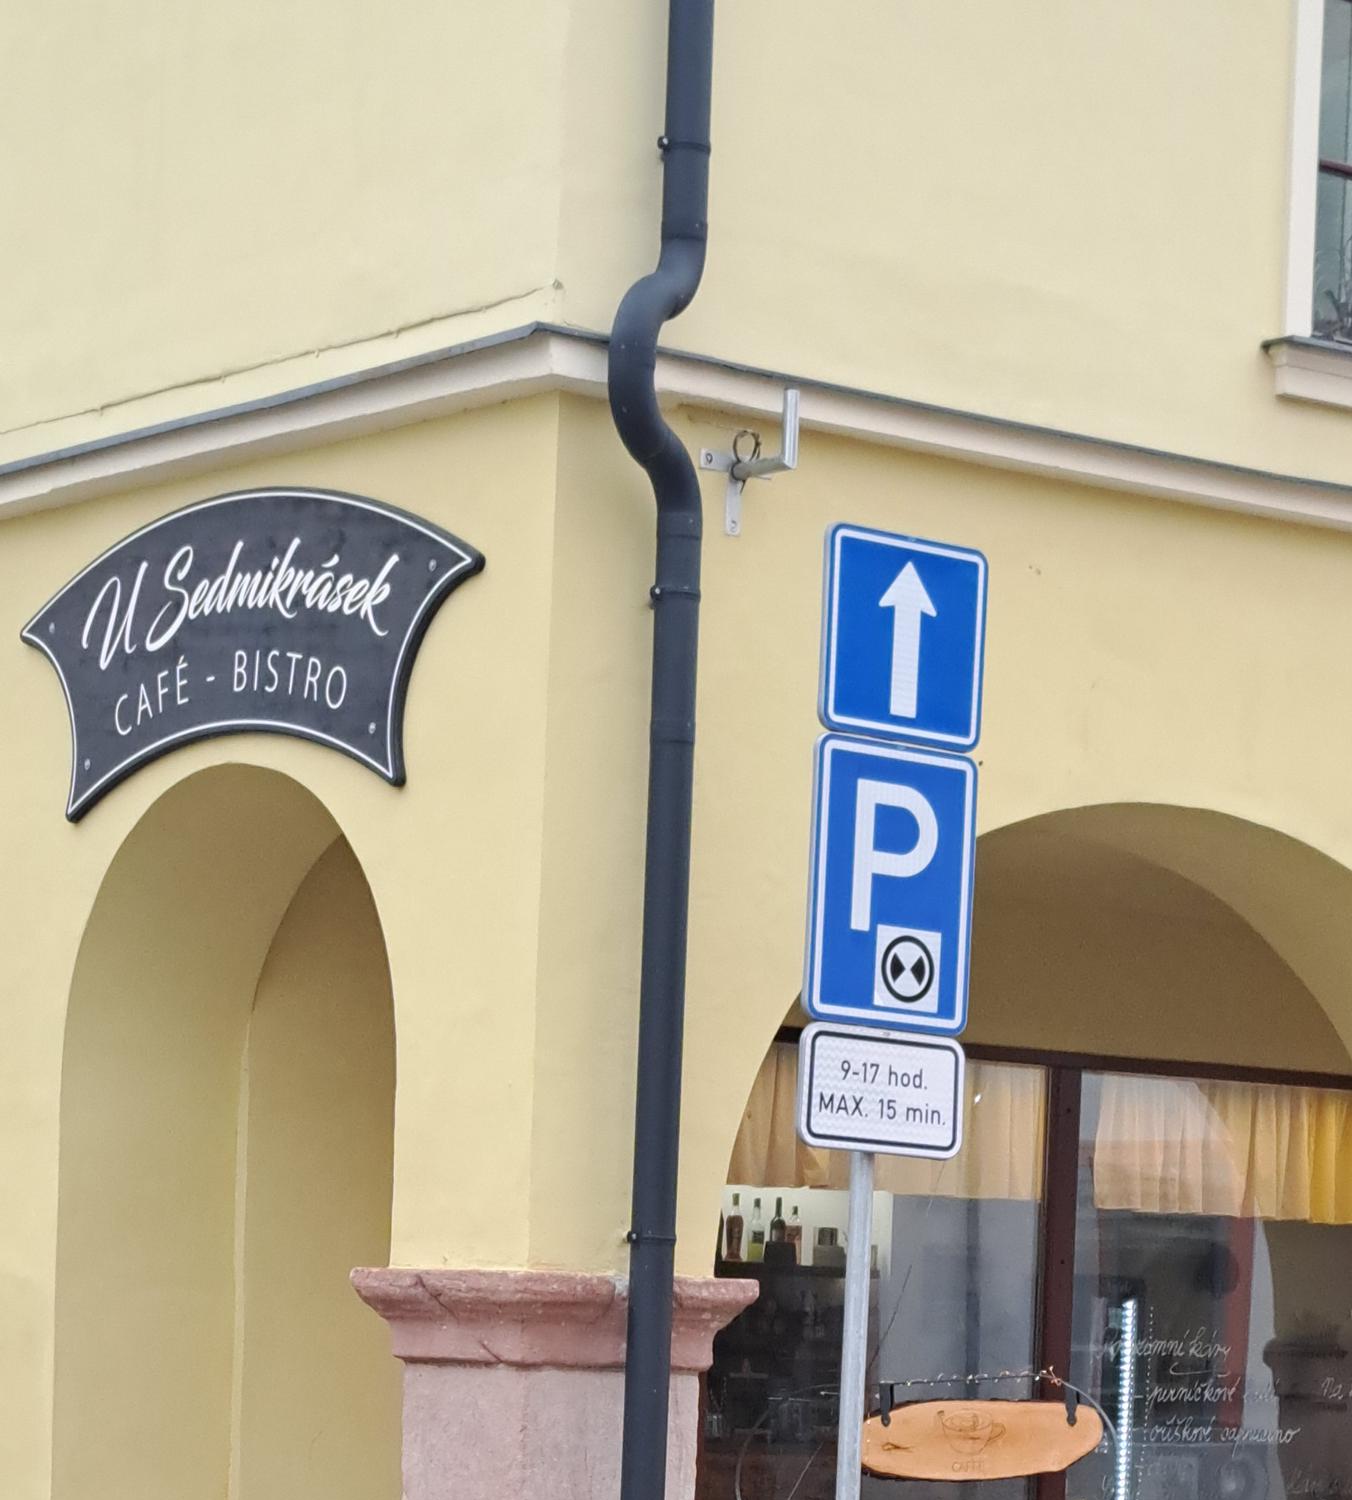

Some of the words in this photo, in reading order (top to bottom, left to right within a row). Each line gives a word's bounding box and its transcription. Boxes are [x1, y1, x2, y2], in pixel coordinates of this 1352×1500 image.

[82, 561, 147, 670] U
[145, 537, 400, 651] Sedmikrásek
[115, 655, 190, 735] CAFÉ
[232, 649, 347, 709] BISTRO
[850, 778, 939, 932] P
[818, 1091, 868, 1118] MAX.
[878, 1098, 897, 1120] 15
[906, 1103, 946, 1126] min.
[841, 1060, 880, 1084] 9-17
[888, 1065, 928, 1090] hod.
